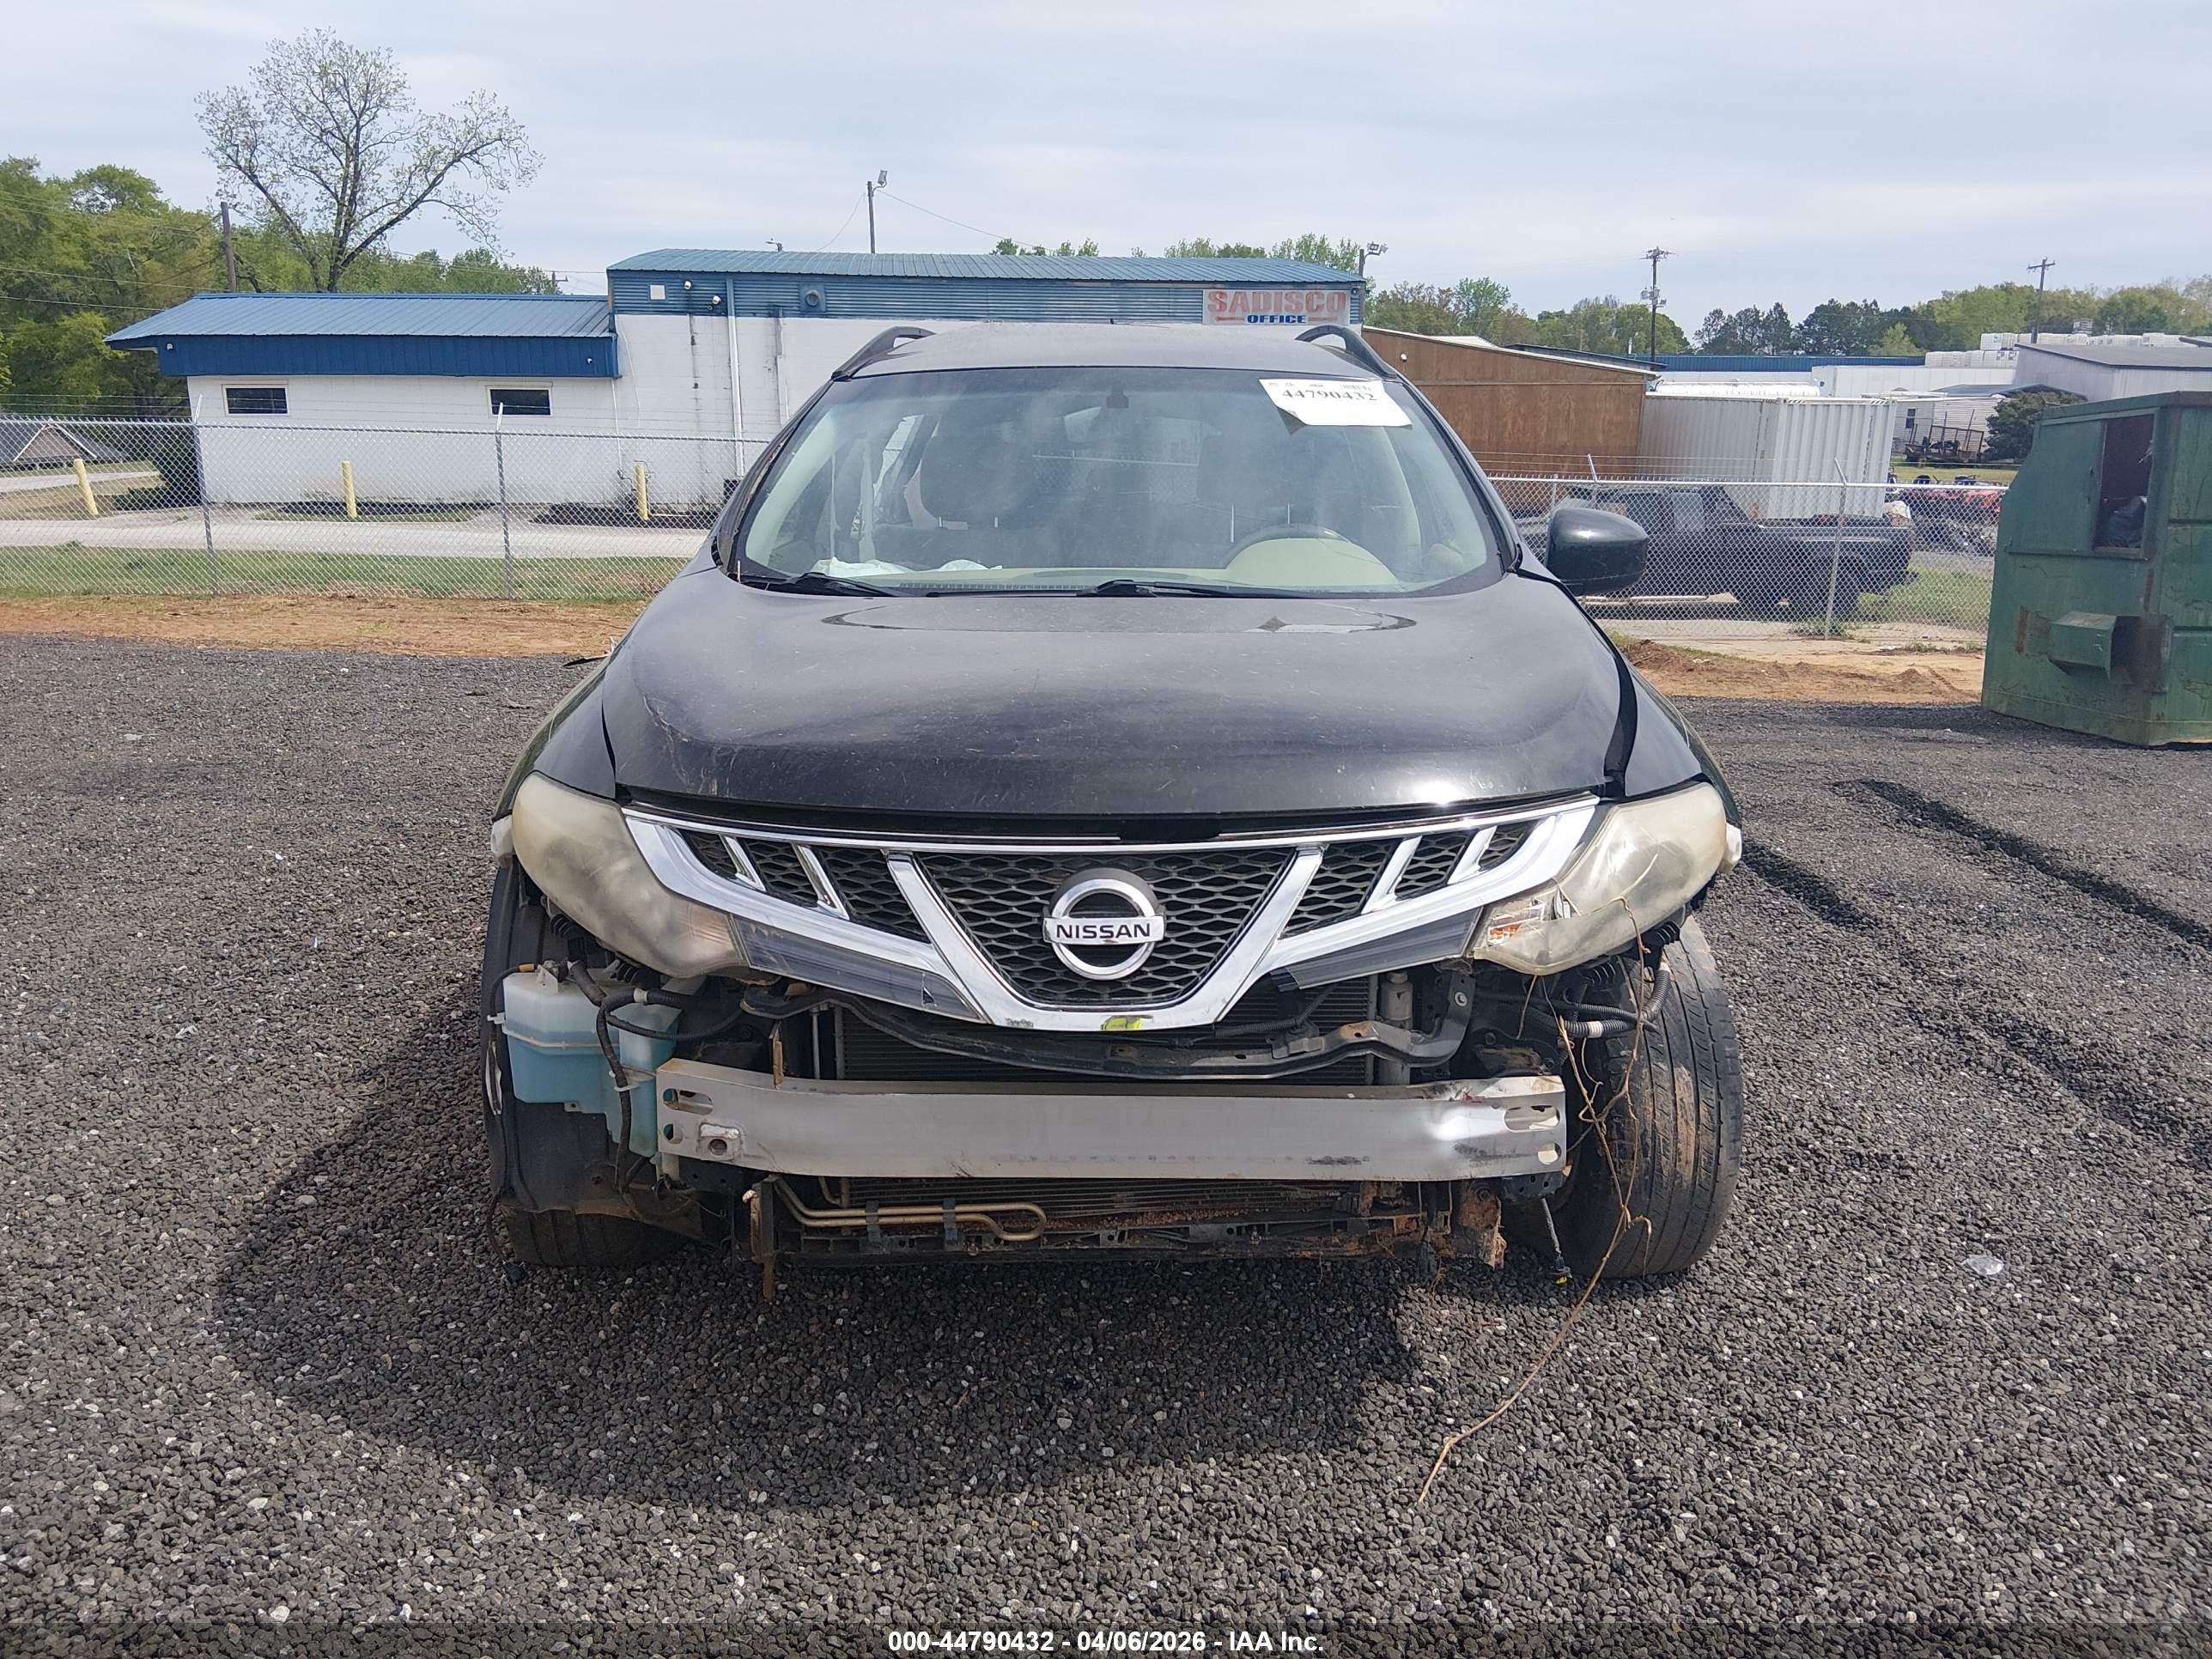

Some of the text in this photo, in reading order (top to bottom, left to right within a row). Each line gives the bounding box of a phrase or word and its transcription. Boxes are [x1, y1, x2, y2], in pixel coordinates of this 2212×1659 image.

[1206, 290, 1346, 313] SADISCO
[1246, 314, 1306, 324] OFFICE
[1282, 389, 1377, 401] 44790432
[1056, 922, 1151, 939] NISSAN
